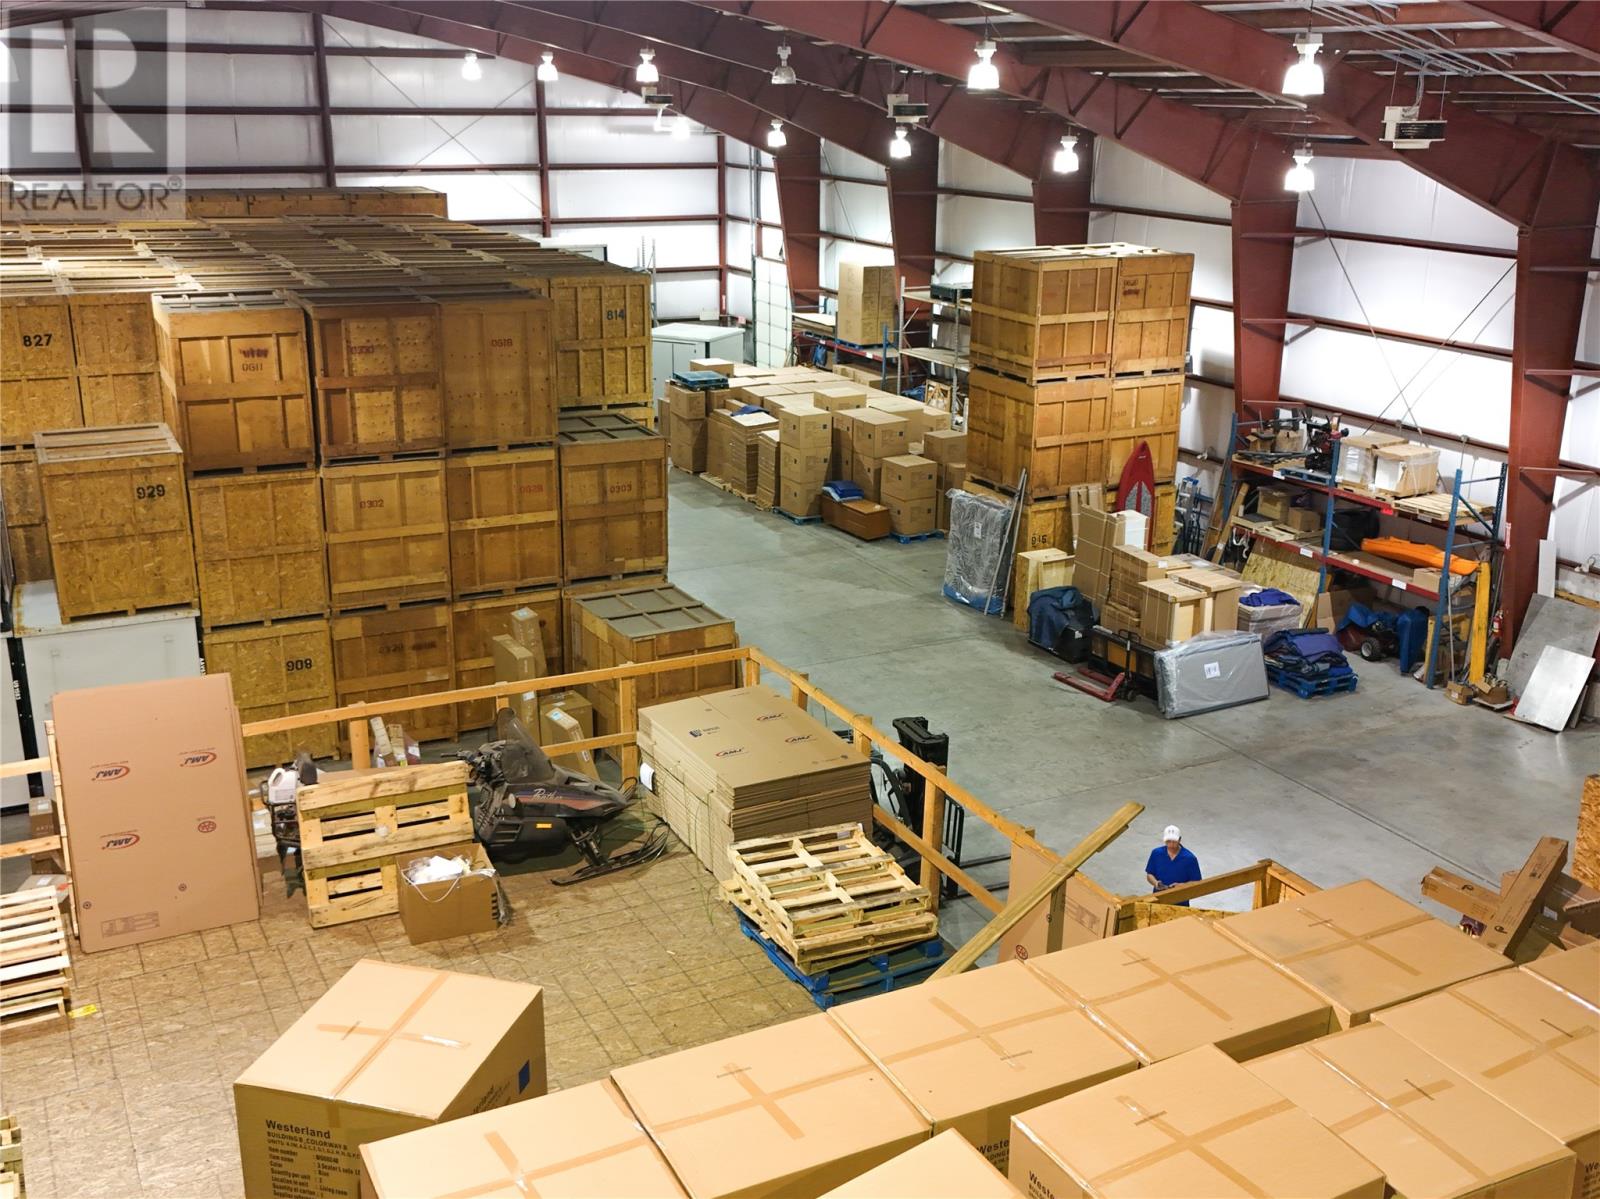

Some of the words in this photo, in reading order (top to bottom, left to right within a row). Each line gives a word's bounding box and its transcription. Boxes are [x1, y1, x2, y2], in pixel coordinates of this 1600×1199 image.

[606, 309, 626, 321] 814
[22, 334, 52, 347] 827
[136, 484, 166, 499] 929
[286, 658, 313, 672] 908
[265, 1119, 331, 1139] Westerland
